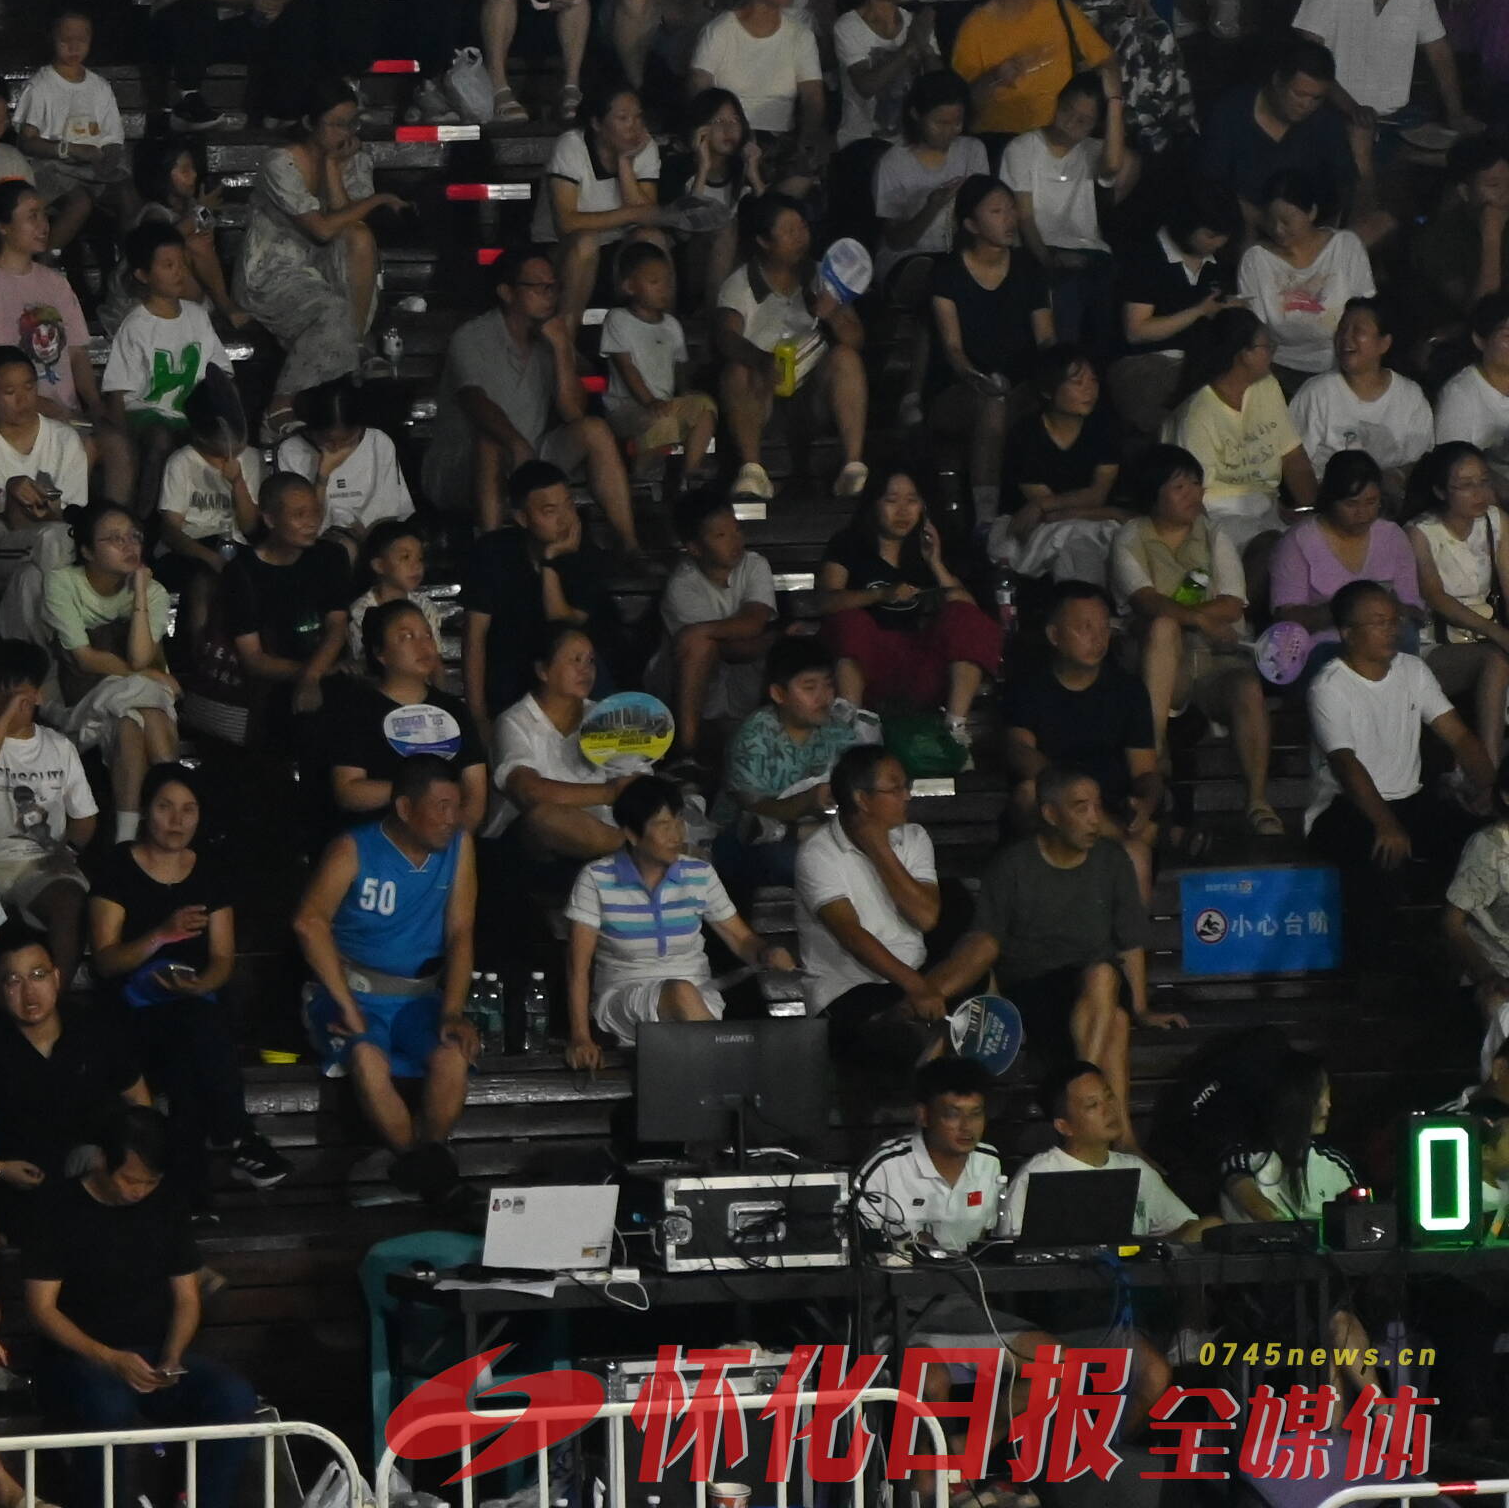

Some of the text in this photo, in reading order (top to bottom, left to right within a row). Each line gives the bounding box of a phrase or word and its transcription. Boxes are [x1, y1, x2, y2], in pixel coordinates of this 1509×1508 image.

[359, 876, 396, 917] 50
[1230, 909, 1329, 939] 小心台阶
[1418, 1127, 1471, 1231] 0
